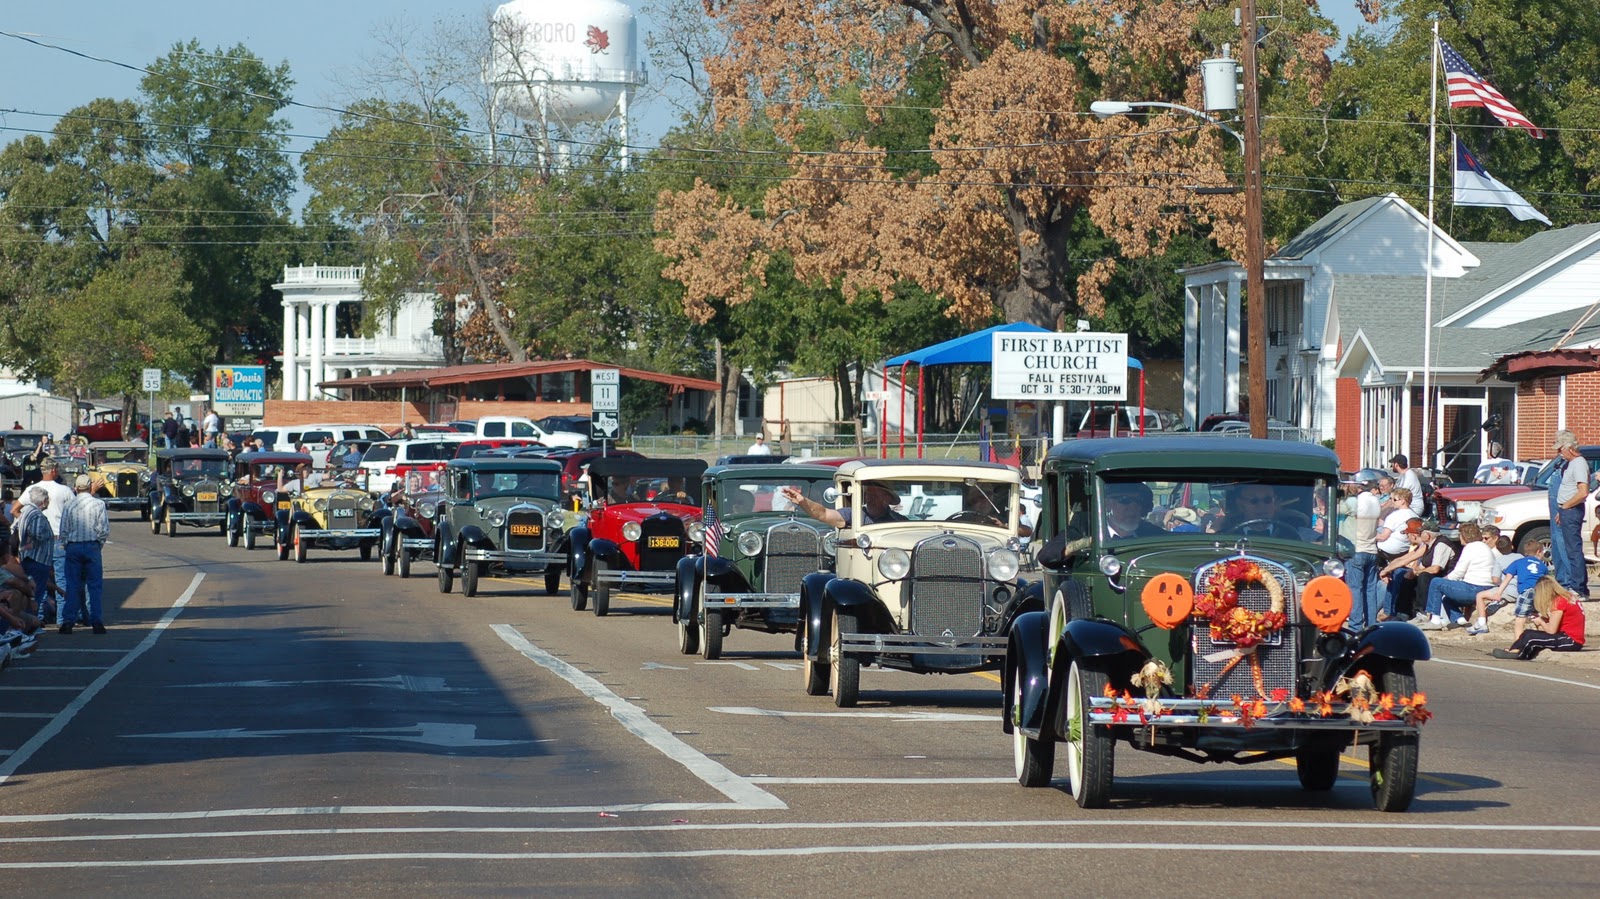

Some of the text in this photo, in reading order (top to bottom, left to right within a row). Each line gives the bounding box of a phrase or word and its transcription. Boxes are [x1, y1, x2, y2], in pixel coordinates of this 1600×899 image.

[1001, 338, 1122, 353] FIRST BAPTIST
[1023, 355, 1098, 370] CHURCH
[233, 371, 262, 383] Davis
[1028, 374, 1108, 383] FALL FESTIVAL
[145, 380, 159, 388] 35
[1021, 384, 1038, 394] OCT
[1043, 385, 1053, 394] 31
[216, 388, 263, 401] CHIROPRACTIC
[601, 387, 610, 399] 11
[1527, 563, 1539, 574] 4
